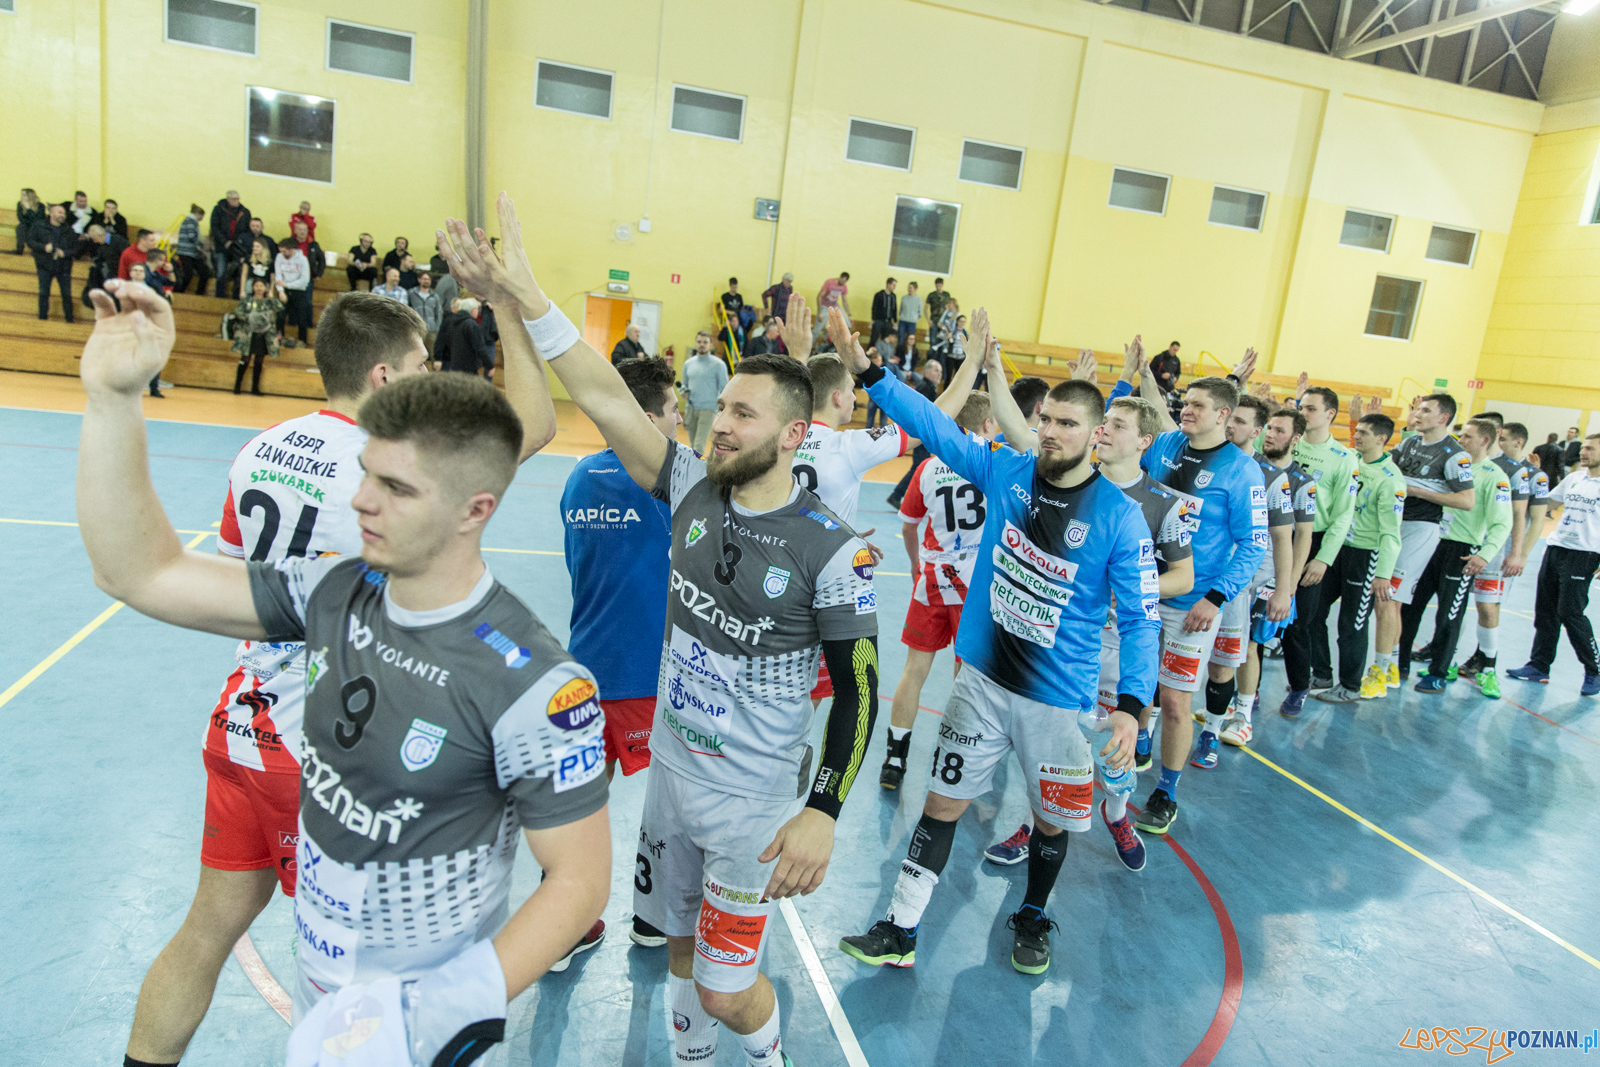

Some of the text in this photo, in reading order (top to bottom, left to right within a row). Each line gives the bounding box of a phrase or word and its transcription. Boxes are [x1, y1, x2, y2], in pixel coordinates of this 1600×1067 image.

[255, 442, 338, 478] ZAWADZKIE
[283, 430, 325, 455] ASPR
[250, 469, 326, 504] SZUWAREK
[935, 484, 986, 532] 13
[733, 522, 788, 548] VOLANTE
[713, 541, 743, 587] 3
[1022, 542, 1068, 580] VEOLIA
[993, 580, 1055, 625] netronik
[375, 642, 450, 687] VOLANTE
[671, 649, 729, 687] GRUNDFOS
[213, 713, 283, 745] tracktec
[334, 675, 377, 751] 9
[663, 707, 725, 755] netronik
[815, 766, 833, 794] SELECT
[931, 746, 964, 786] 18
[1049, 766, 1087, 777] BUTRANS
[634, 853, 652, 895] 3
[710, 882, 759, 904] BUTRANS
[688, 1044, 712, 1054] WKS
